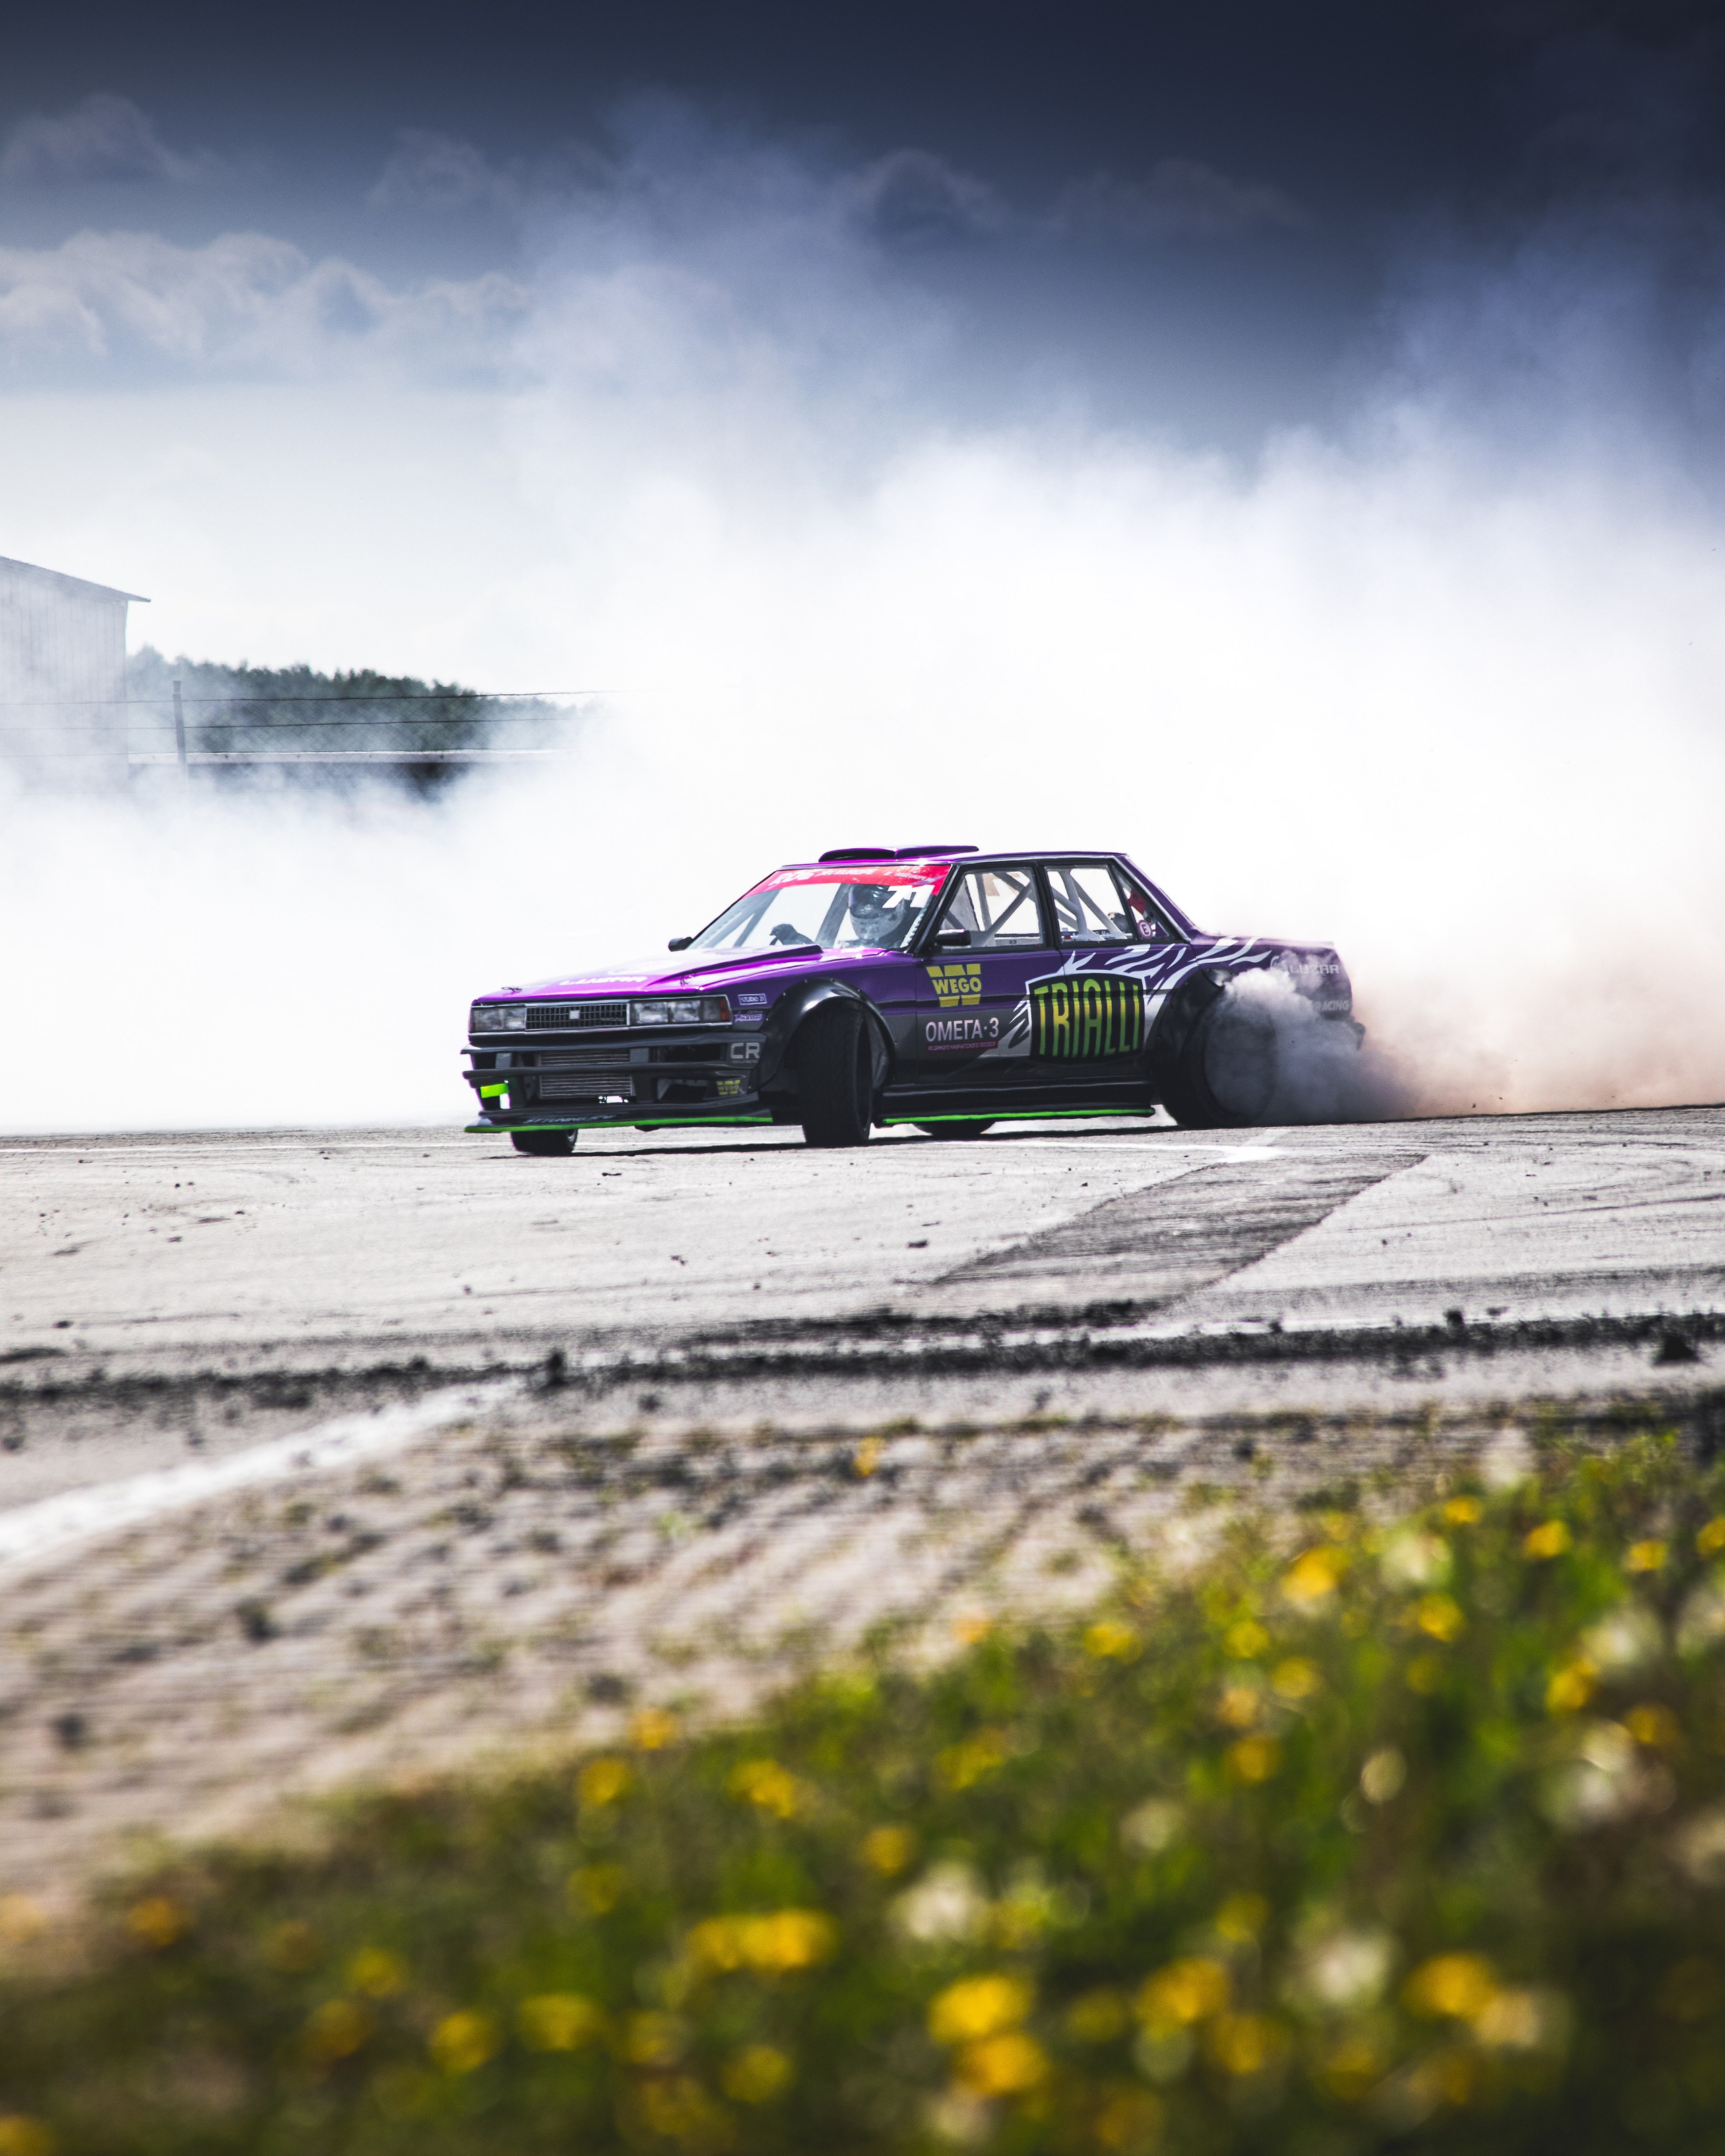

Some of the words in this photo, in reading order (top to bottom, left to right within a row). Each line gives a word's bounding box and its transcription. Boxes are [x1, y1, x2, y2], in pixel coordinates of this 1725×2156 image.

[882, 884, 935, 909] 71
[1141, 924, 1150, 935] E
[1289, 963, 1340, 974] LUZAR
[932, 977, 982, 994] WEGO
[1034, 978, 1140, 1058] TRIALLI
[730, 1042, 761, 1059] CR
